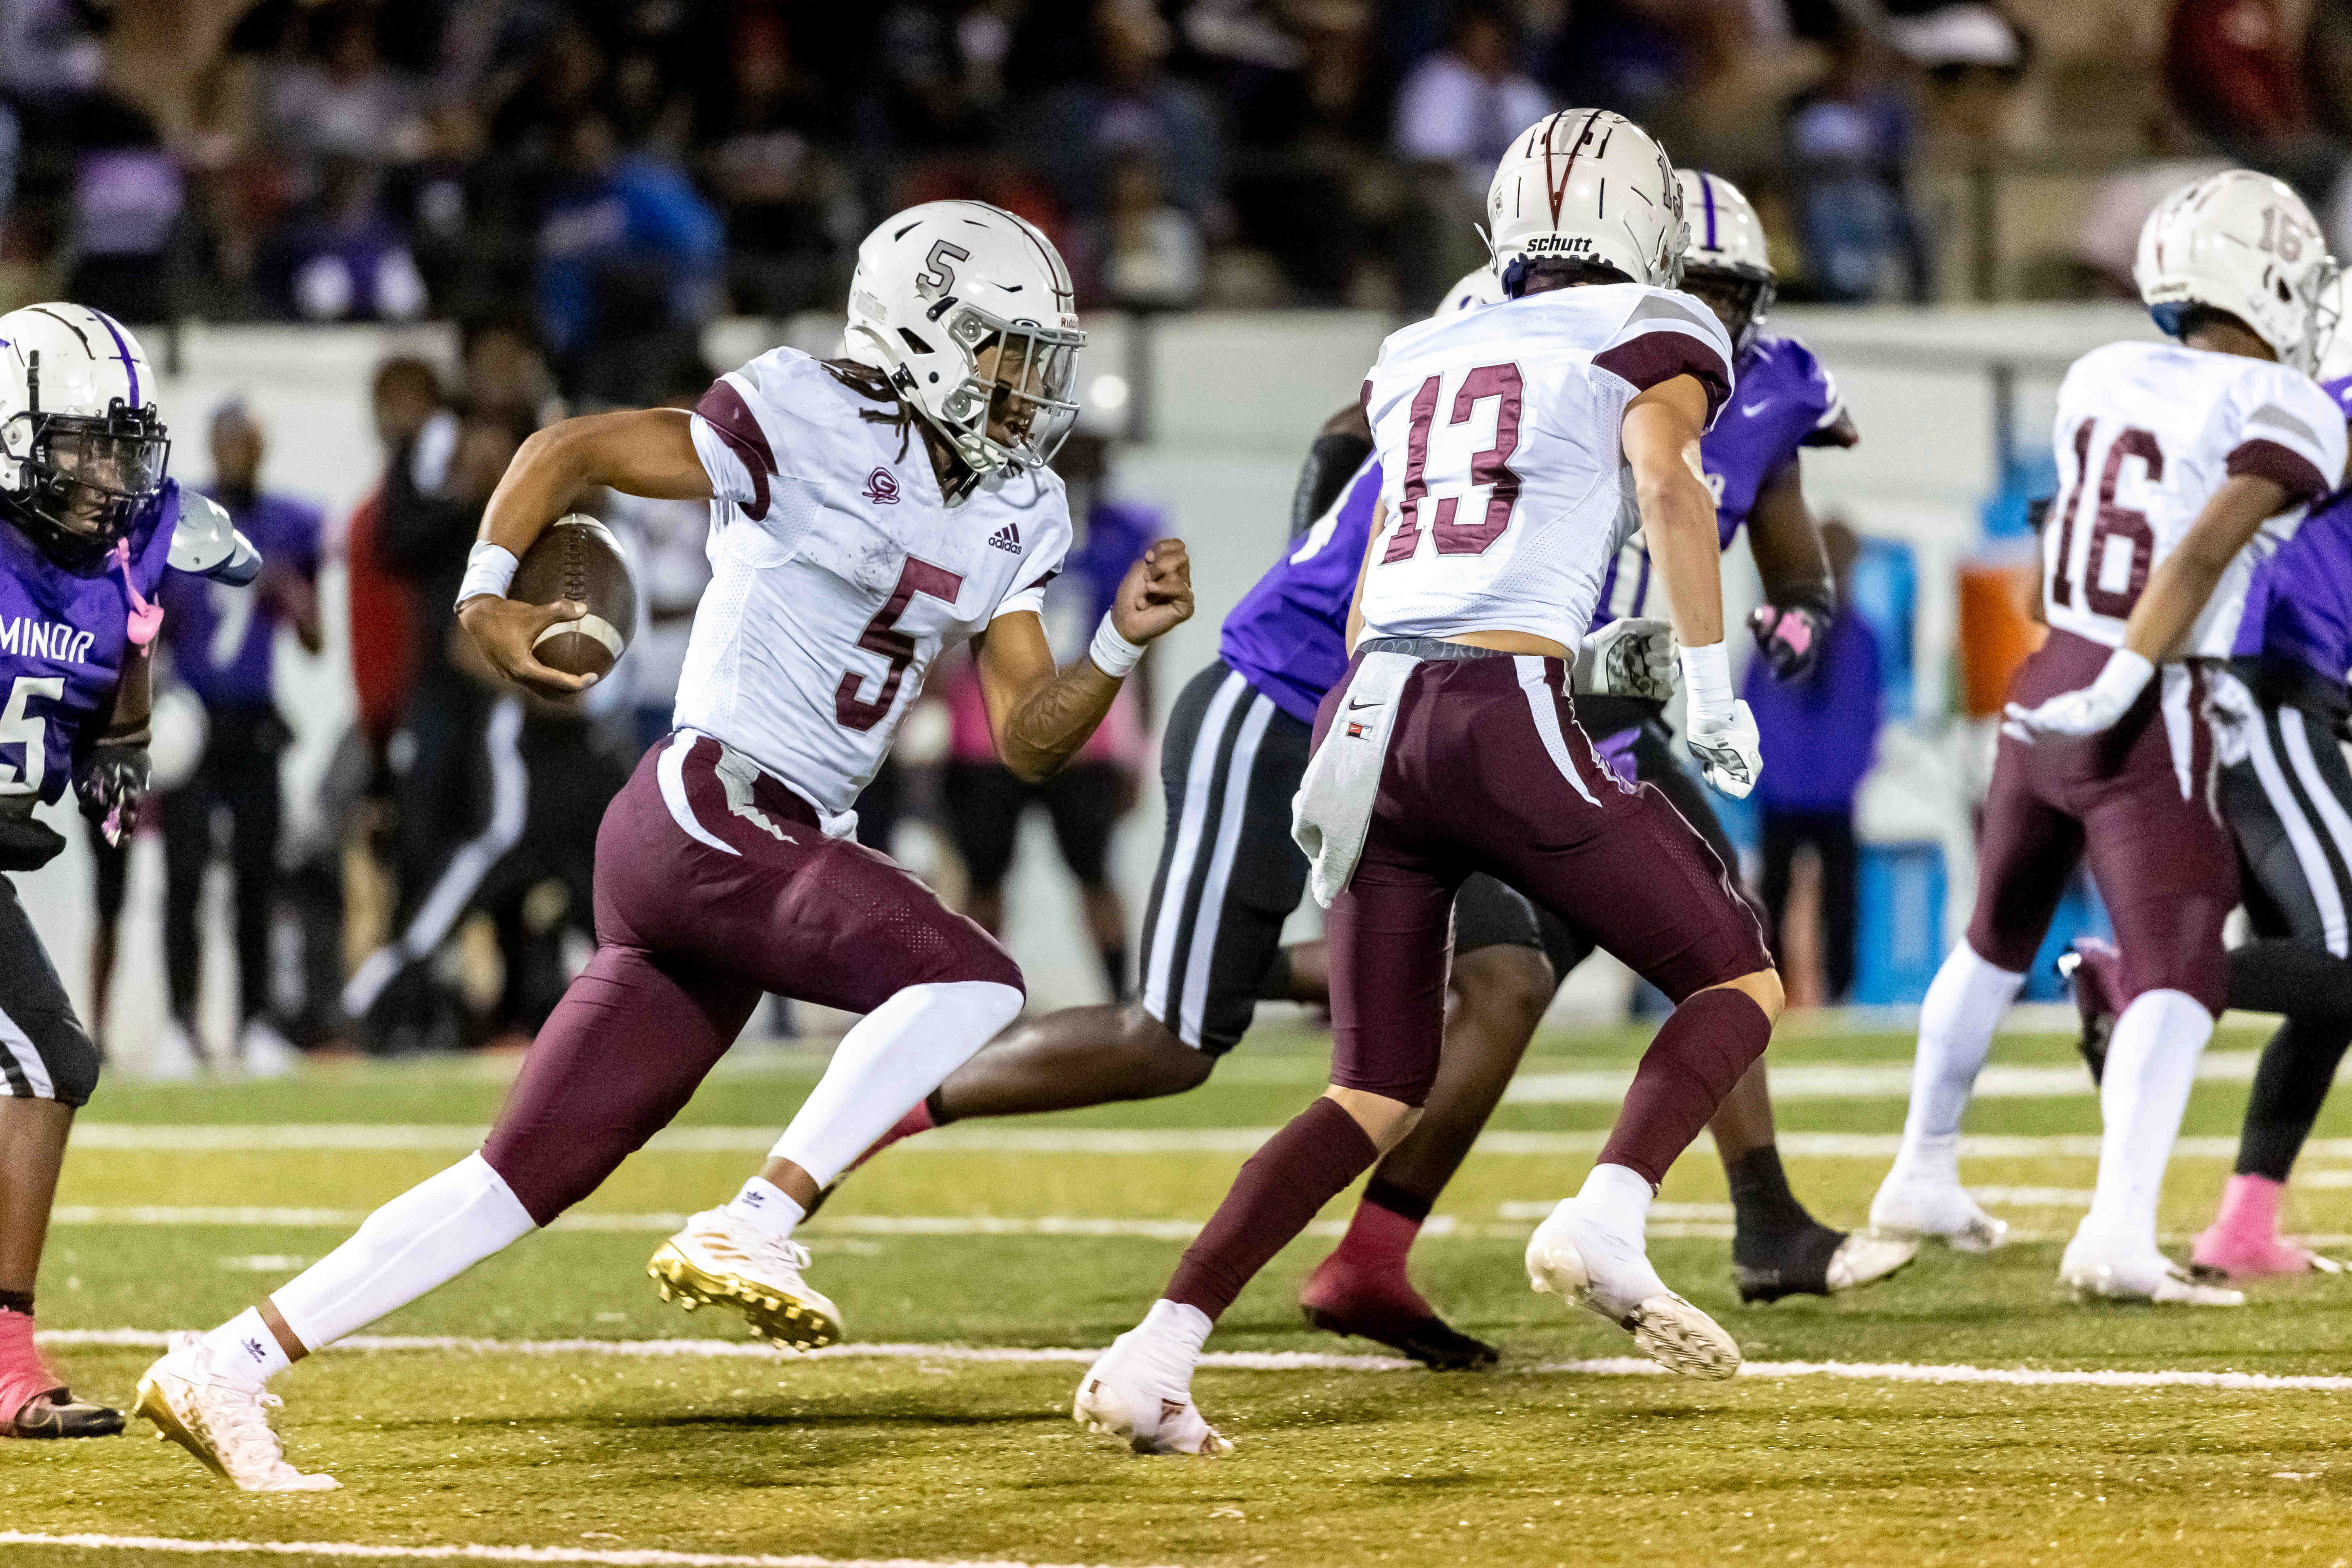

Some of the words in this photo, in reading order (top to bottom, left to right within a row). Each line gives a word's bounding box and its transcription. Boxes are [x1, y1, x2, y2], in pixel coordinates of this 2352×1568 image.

[1527, 233, 1592, 252] schutt
[2257, 207, 2302, 262] 16
[916, 239, 970, 297] 5
[1379, 360, 1525, 565] 13
[988, 537, 1022, 555] adidas
[2054, 417, 2164, 618] 16
[0, 614, 95, 664] MINOR
[834, 554, 966, 733] 5
[0, 676, 65, 795] 5
